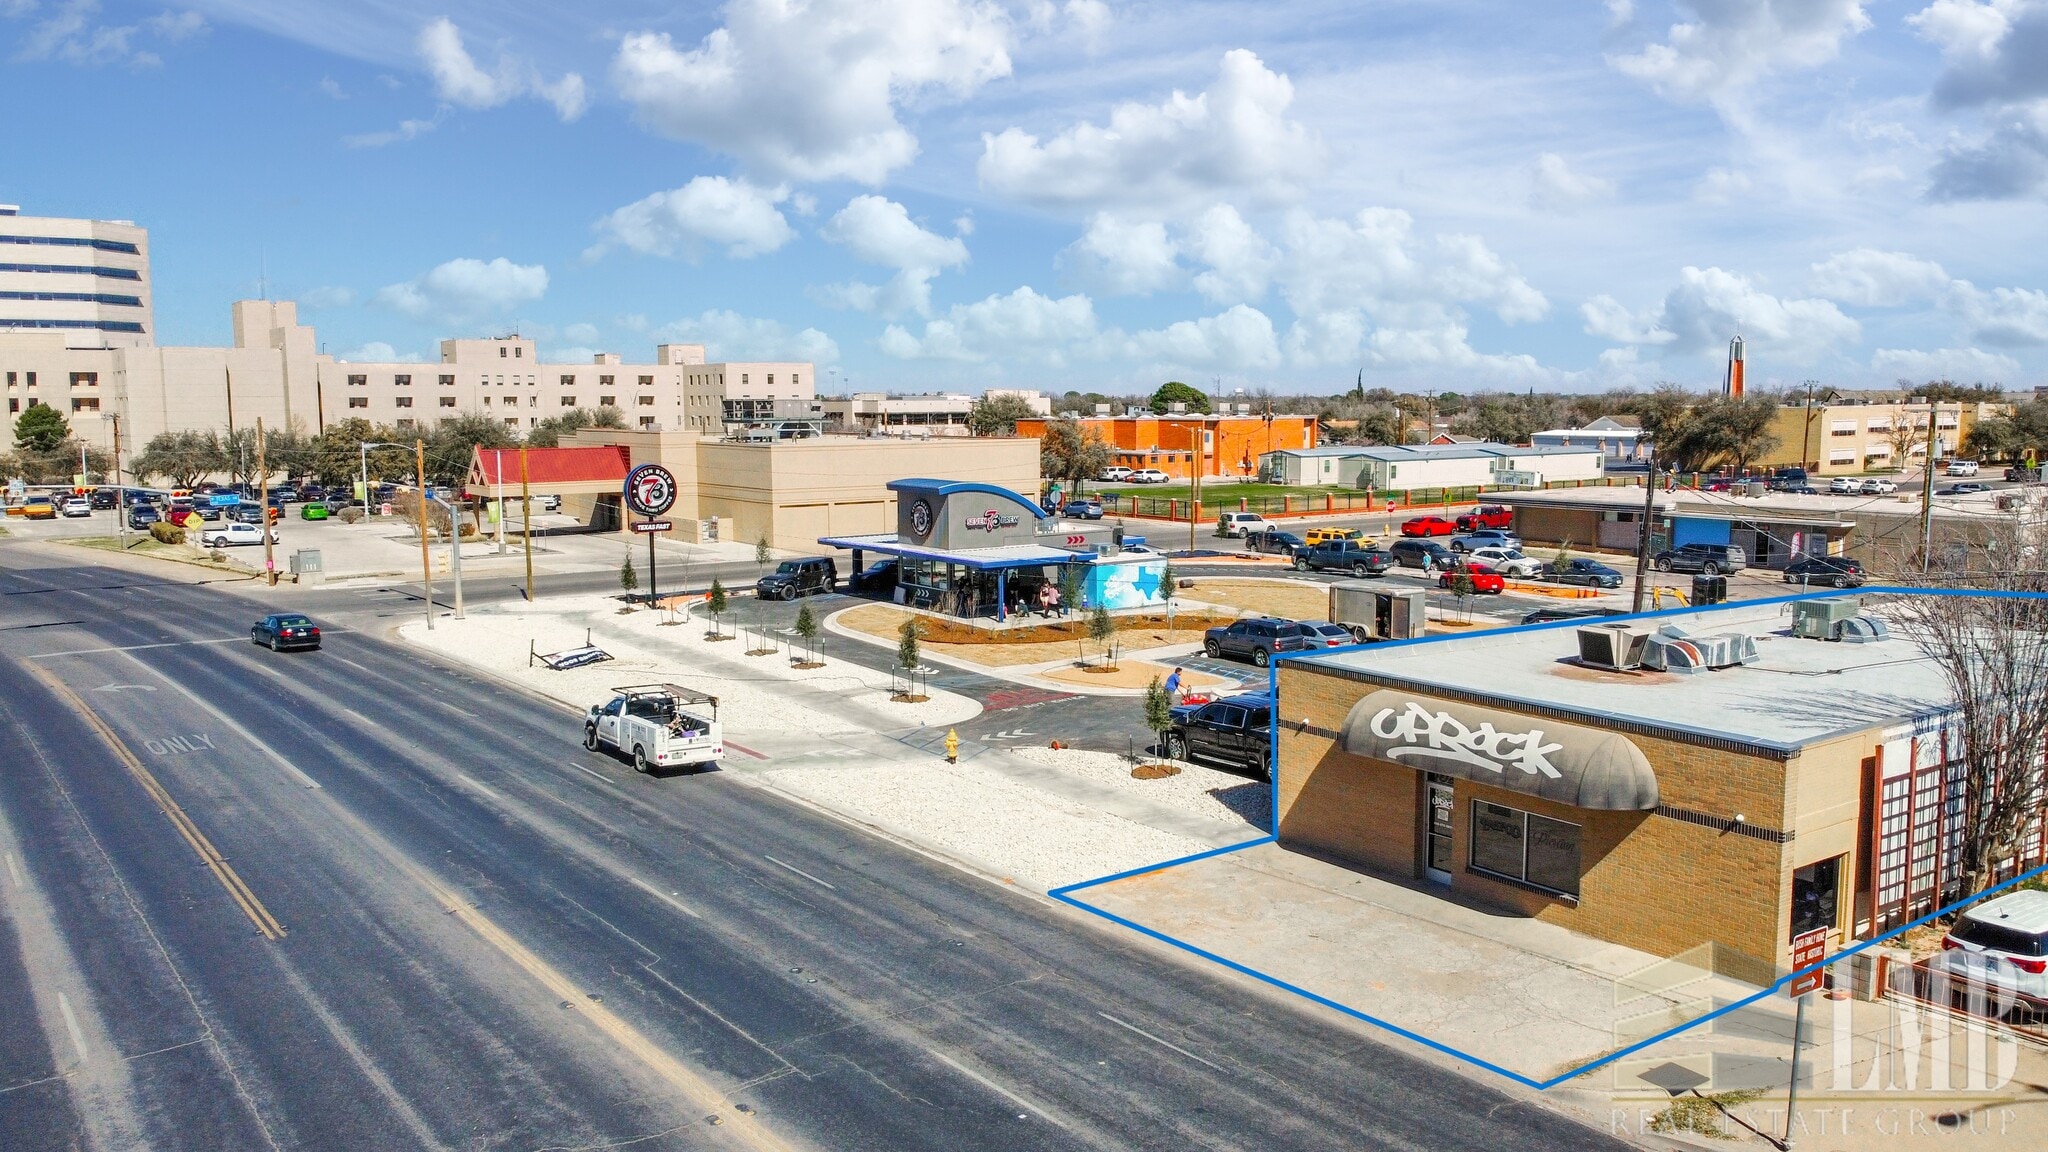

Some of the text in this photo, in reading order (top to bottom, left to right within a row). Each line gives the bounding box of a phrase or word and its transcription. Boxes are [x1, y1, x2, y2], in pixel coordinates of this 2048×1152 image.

[633, 468, 673, 485] SEVEN BREW
[637, 523, 656, 531] TEXAS
[966, 515, 1019, 527] SEVEN BREW
[143, 733, 217, 756] ONLY
[1816, 931, 1826, 942] HOME
[1795, 945, 1823, 964] STATE HISTORIC
